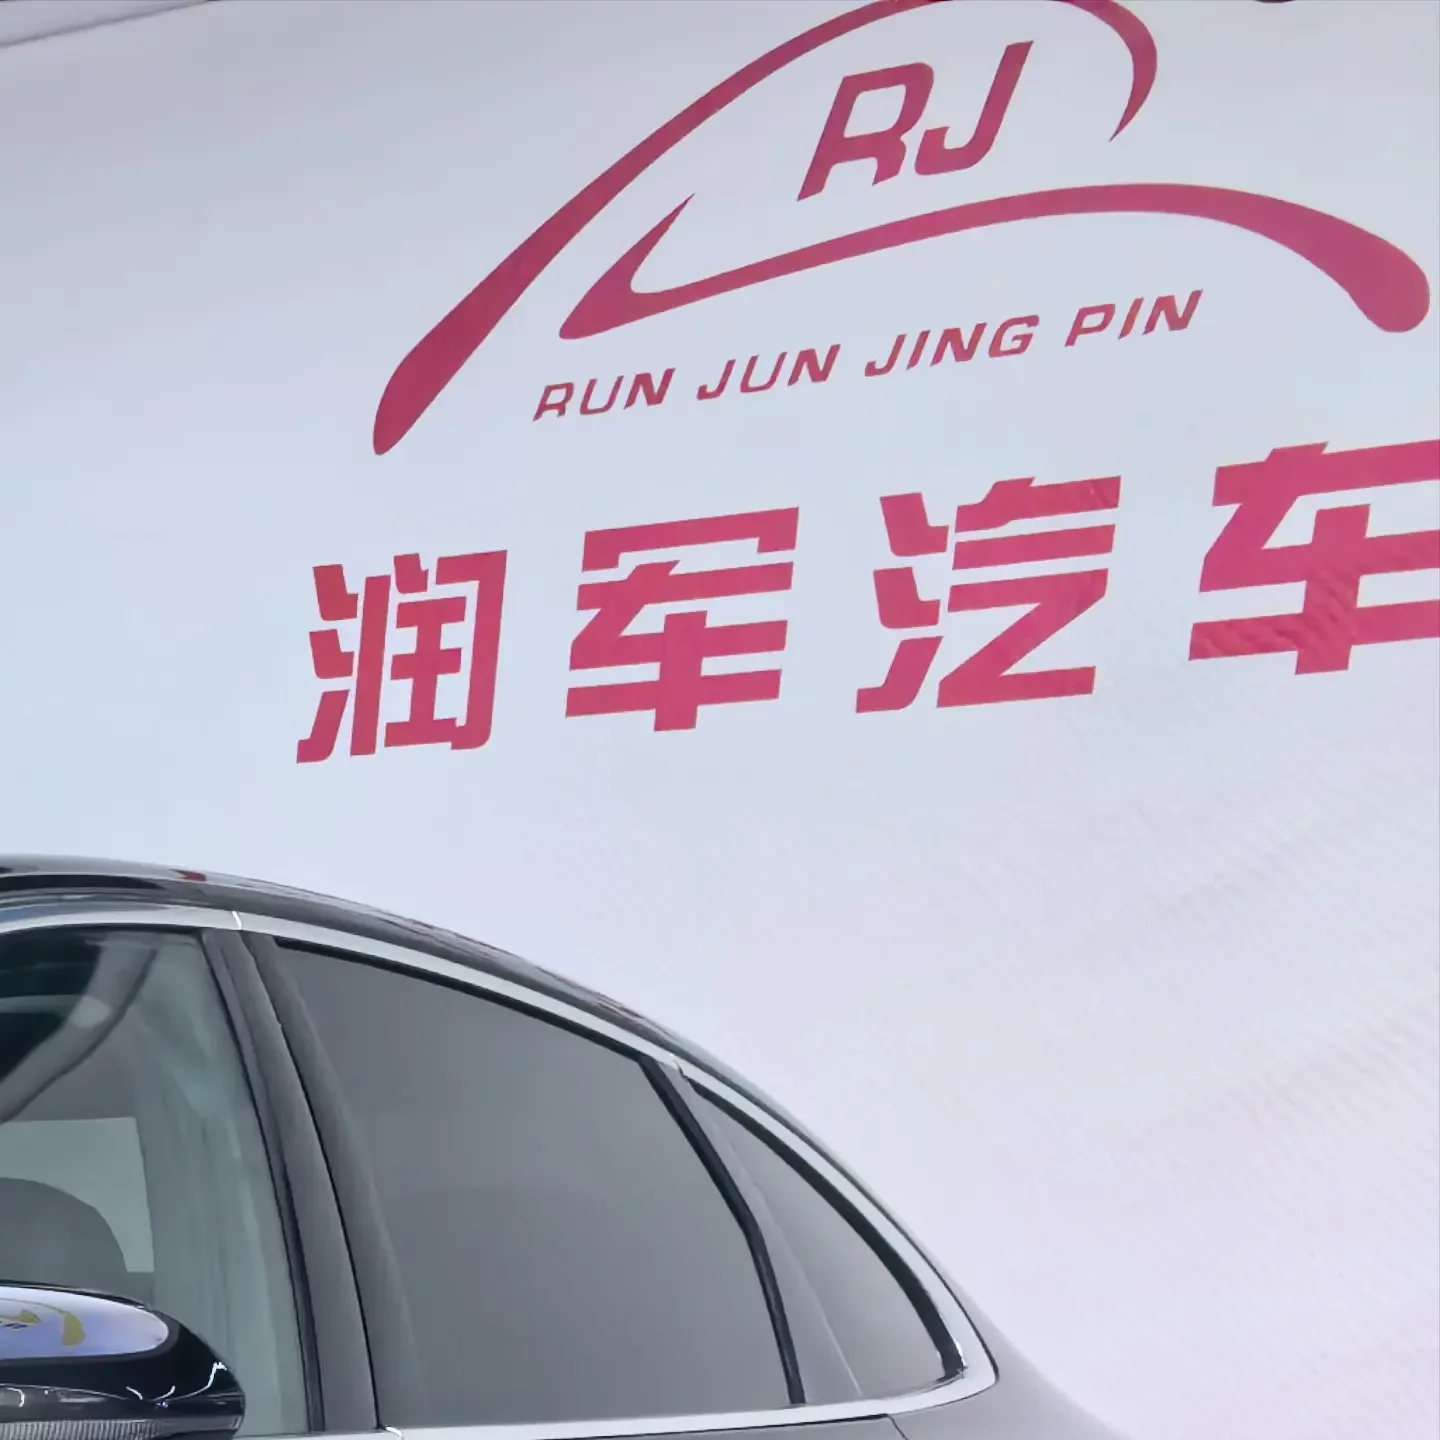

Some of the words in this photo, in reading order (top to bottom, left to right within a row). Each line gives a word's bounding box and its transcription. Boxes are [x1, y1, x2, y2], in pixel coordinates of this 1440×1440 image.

[797, 41, 1033, 200] RJ
[533, 368, 675, 422] RUN
[696, 344, 841, 400] JUN
[865, 314, 1040, 377] JING
[1064, 289, 1204, 347] PIN
[296, 439, 1440, 763] 润军汽车
